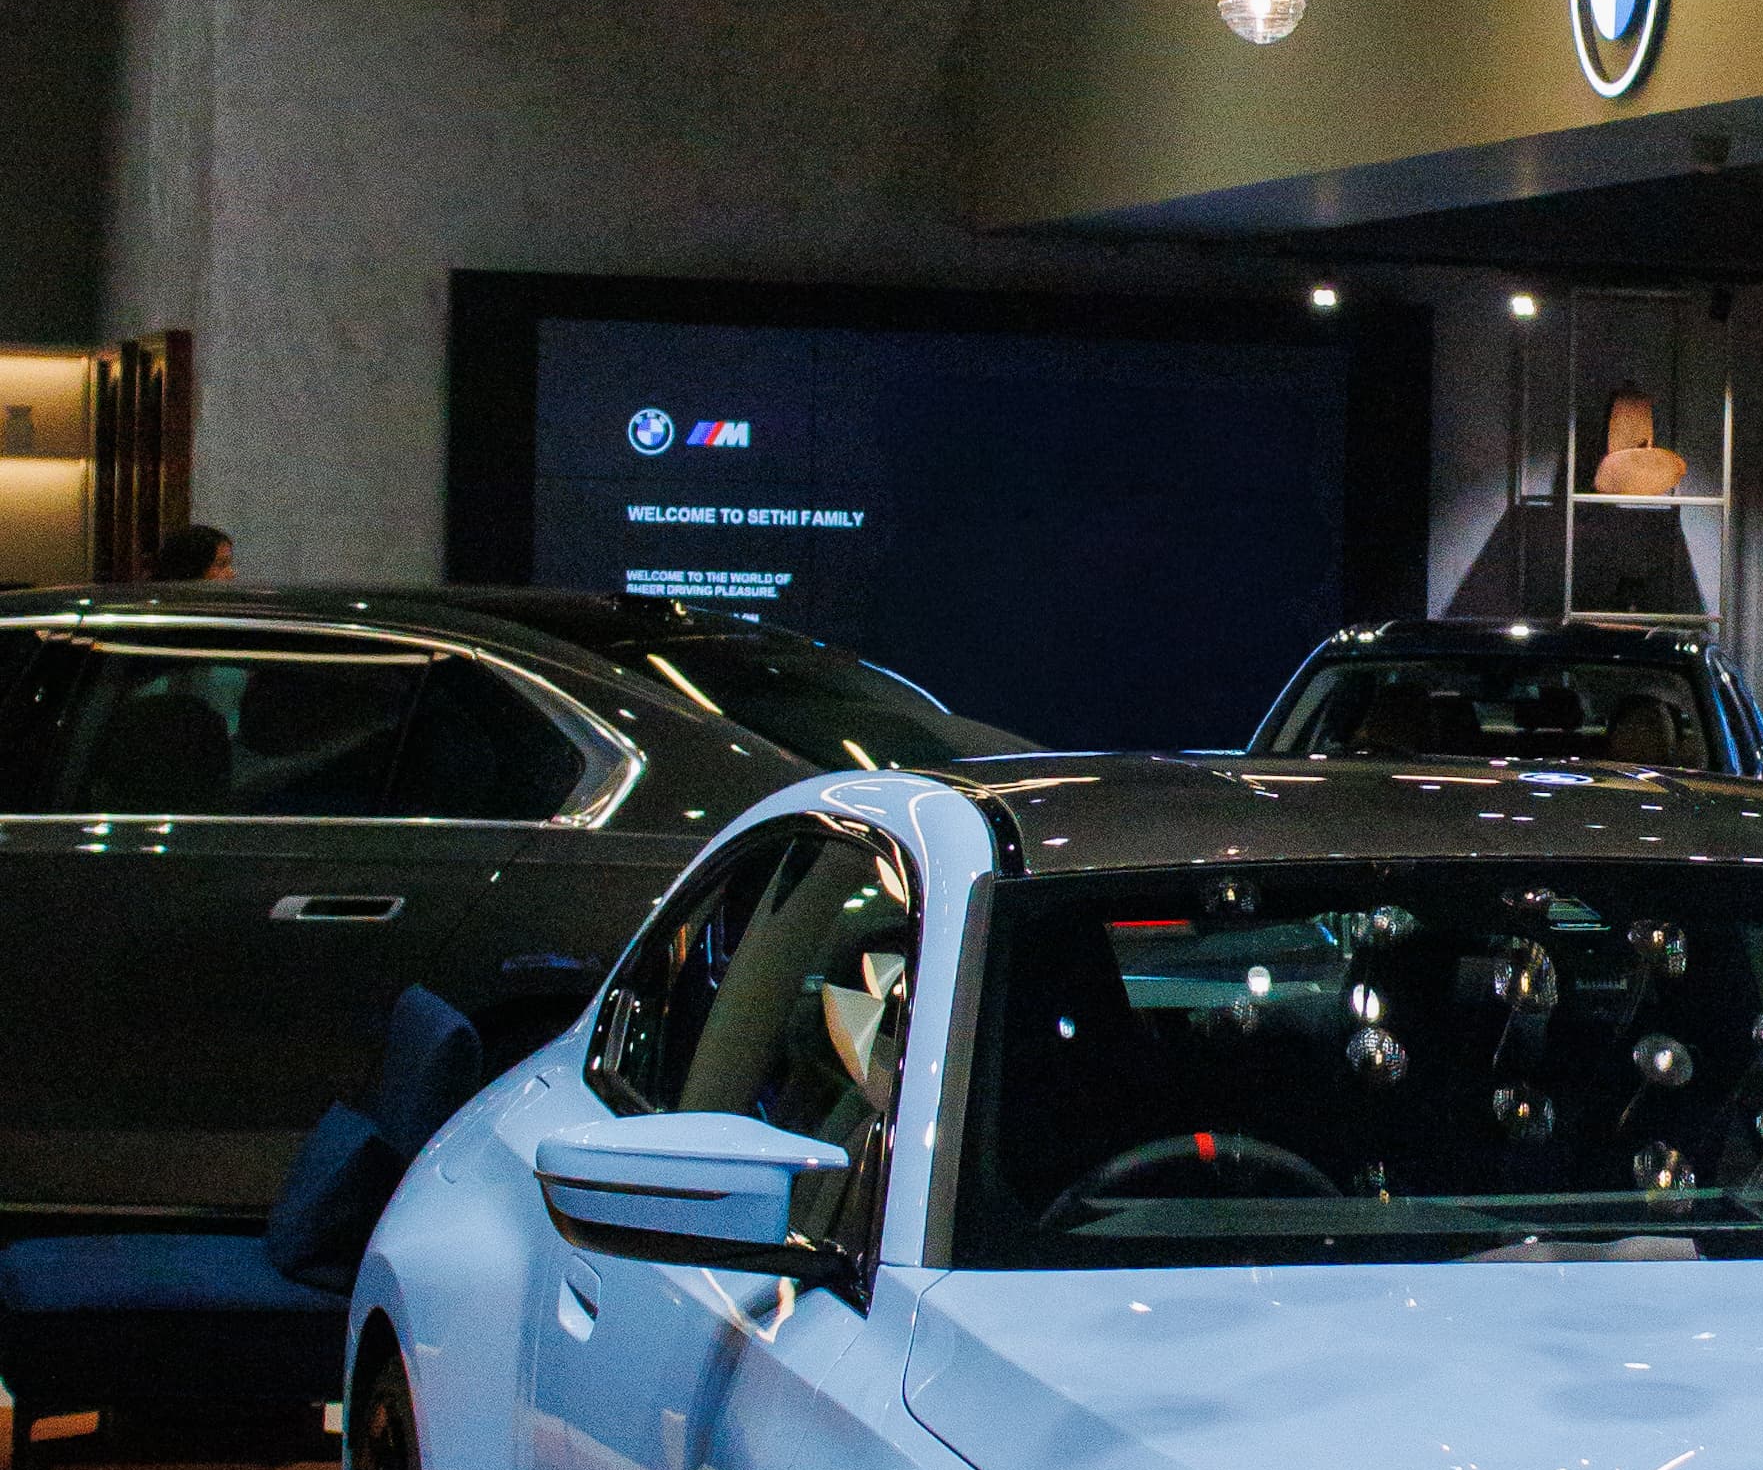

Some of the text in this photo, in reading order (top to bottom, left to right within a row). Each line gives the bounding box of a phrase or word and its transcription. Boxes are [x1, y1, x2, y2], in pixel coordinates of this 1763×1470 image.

[627, 505, 865, 528] WELCOME TO SETHI FAMILY
[626, 569, 792, 586] WELCOME TO THE WORLD OF
[666, 584, 713, 597] DRIVING
